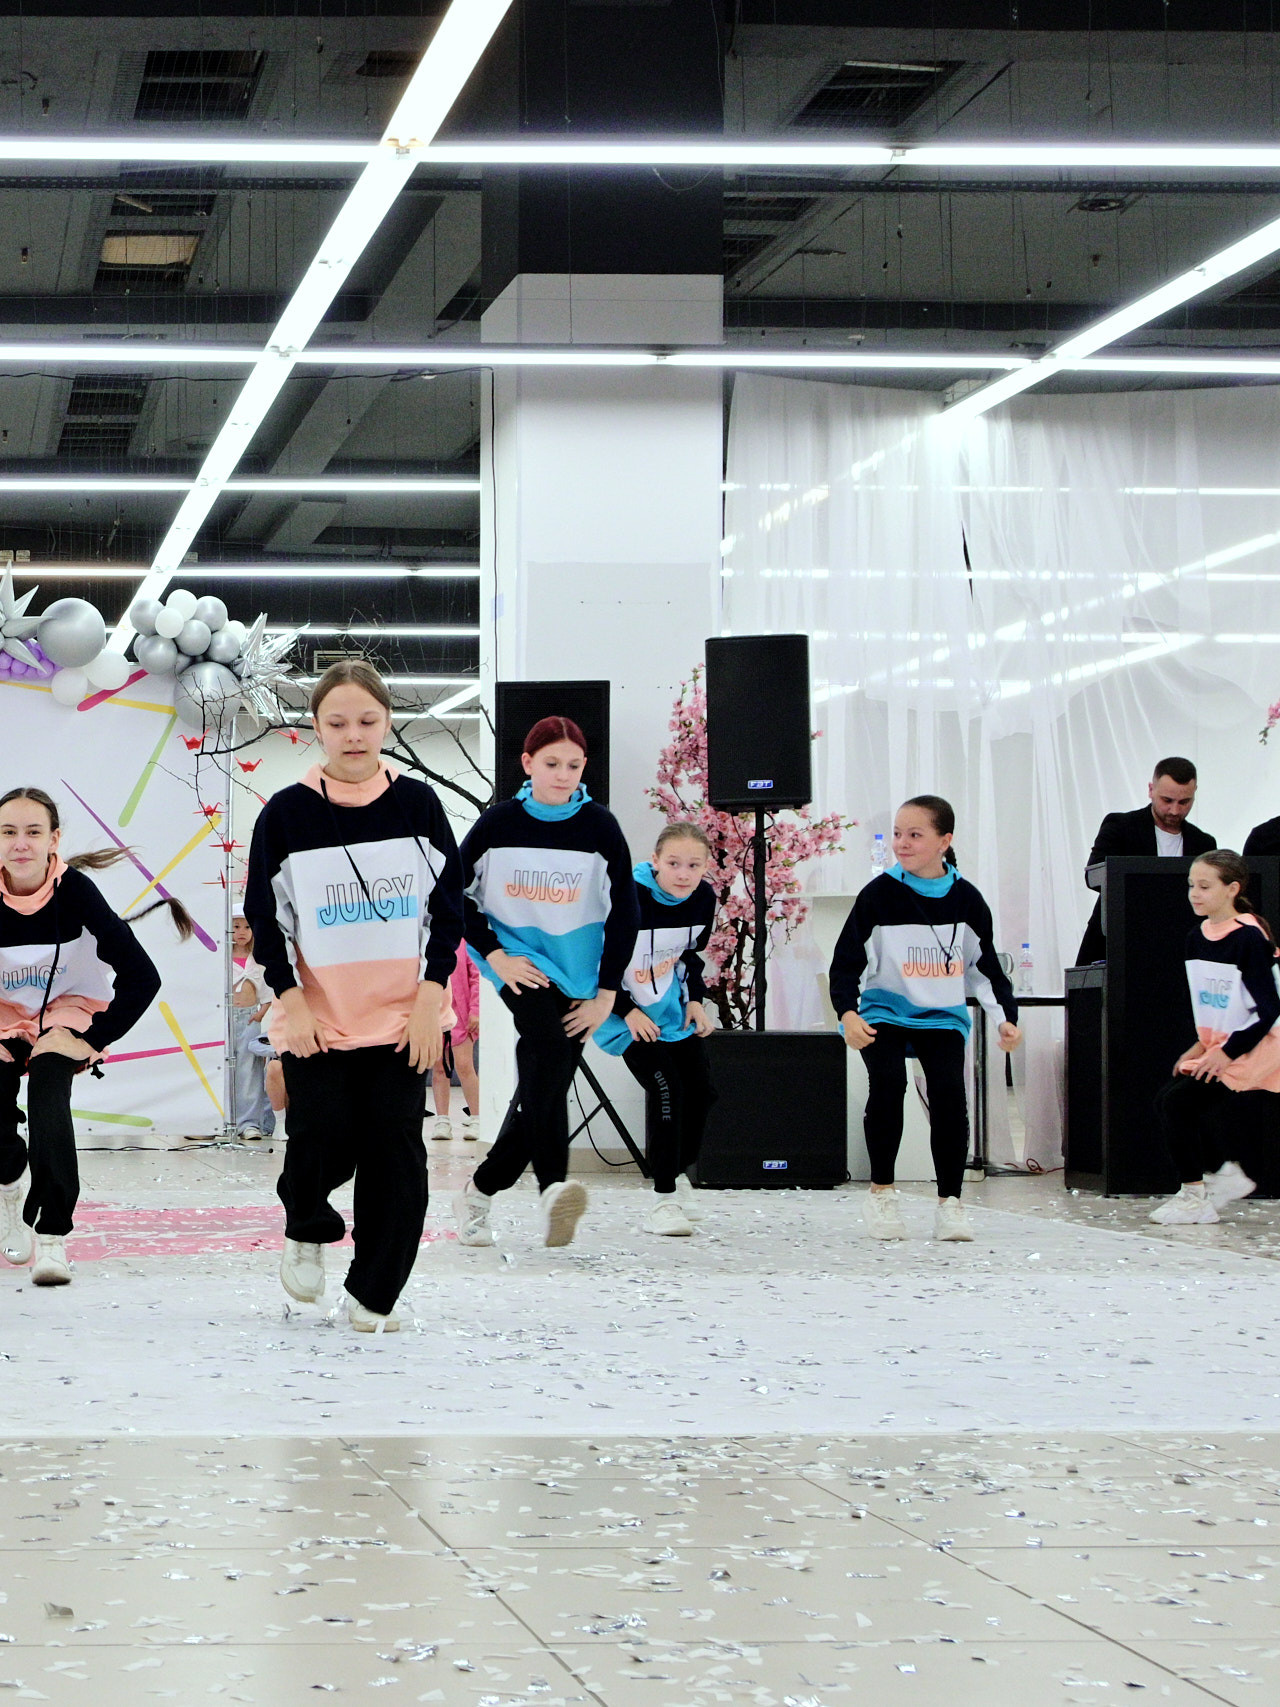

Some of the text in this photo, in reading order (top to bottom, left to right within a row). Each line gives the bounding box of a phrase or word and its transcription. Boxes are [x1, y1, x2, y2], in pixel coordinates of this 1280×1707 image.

[319, 873, 414, 926] JUICY
[506, 869, 583, 903] JUICY
[654, 1070, 672, 1121] OUTRIDE
